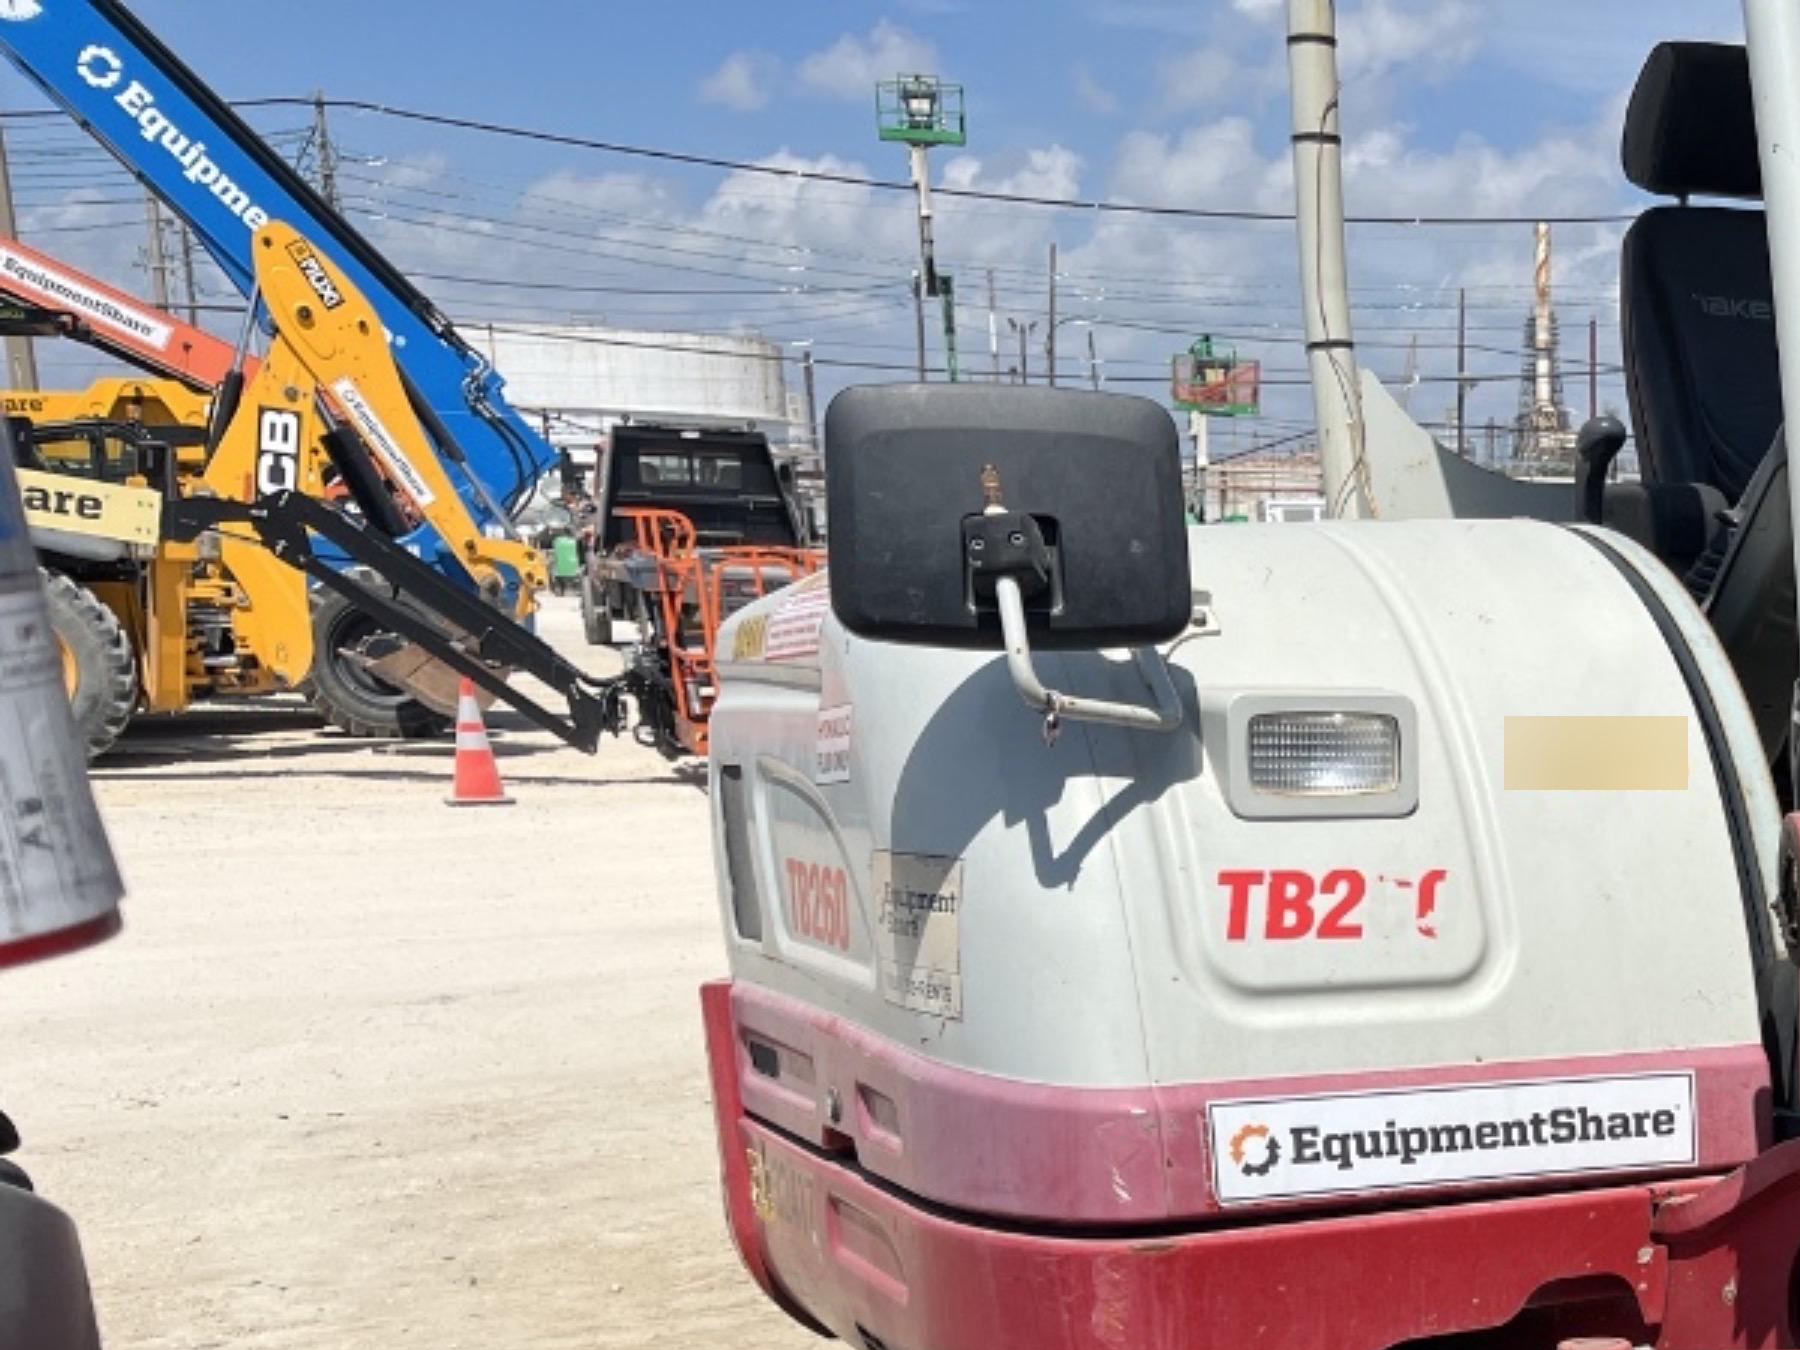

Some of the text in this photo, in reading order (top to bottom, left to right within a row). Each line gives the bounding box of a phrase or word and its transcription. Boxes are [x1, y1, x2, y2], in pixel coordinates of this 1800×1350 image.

[786, 857, 849, 951] TB260
[1217, 868, 1447, 940] TB2
[1289, 1106, 1676, 1171] EquipmentShare
